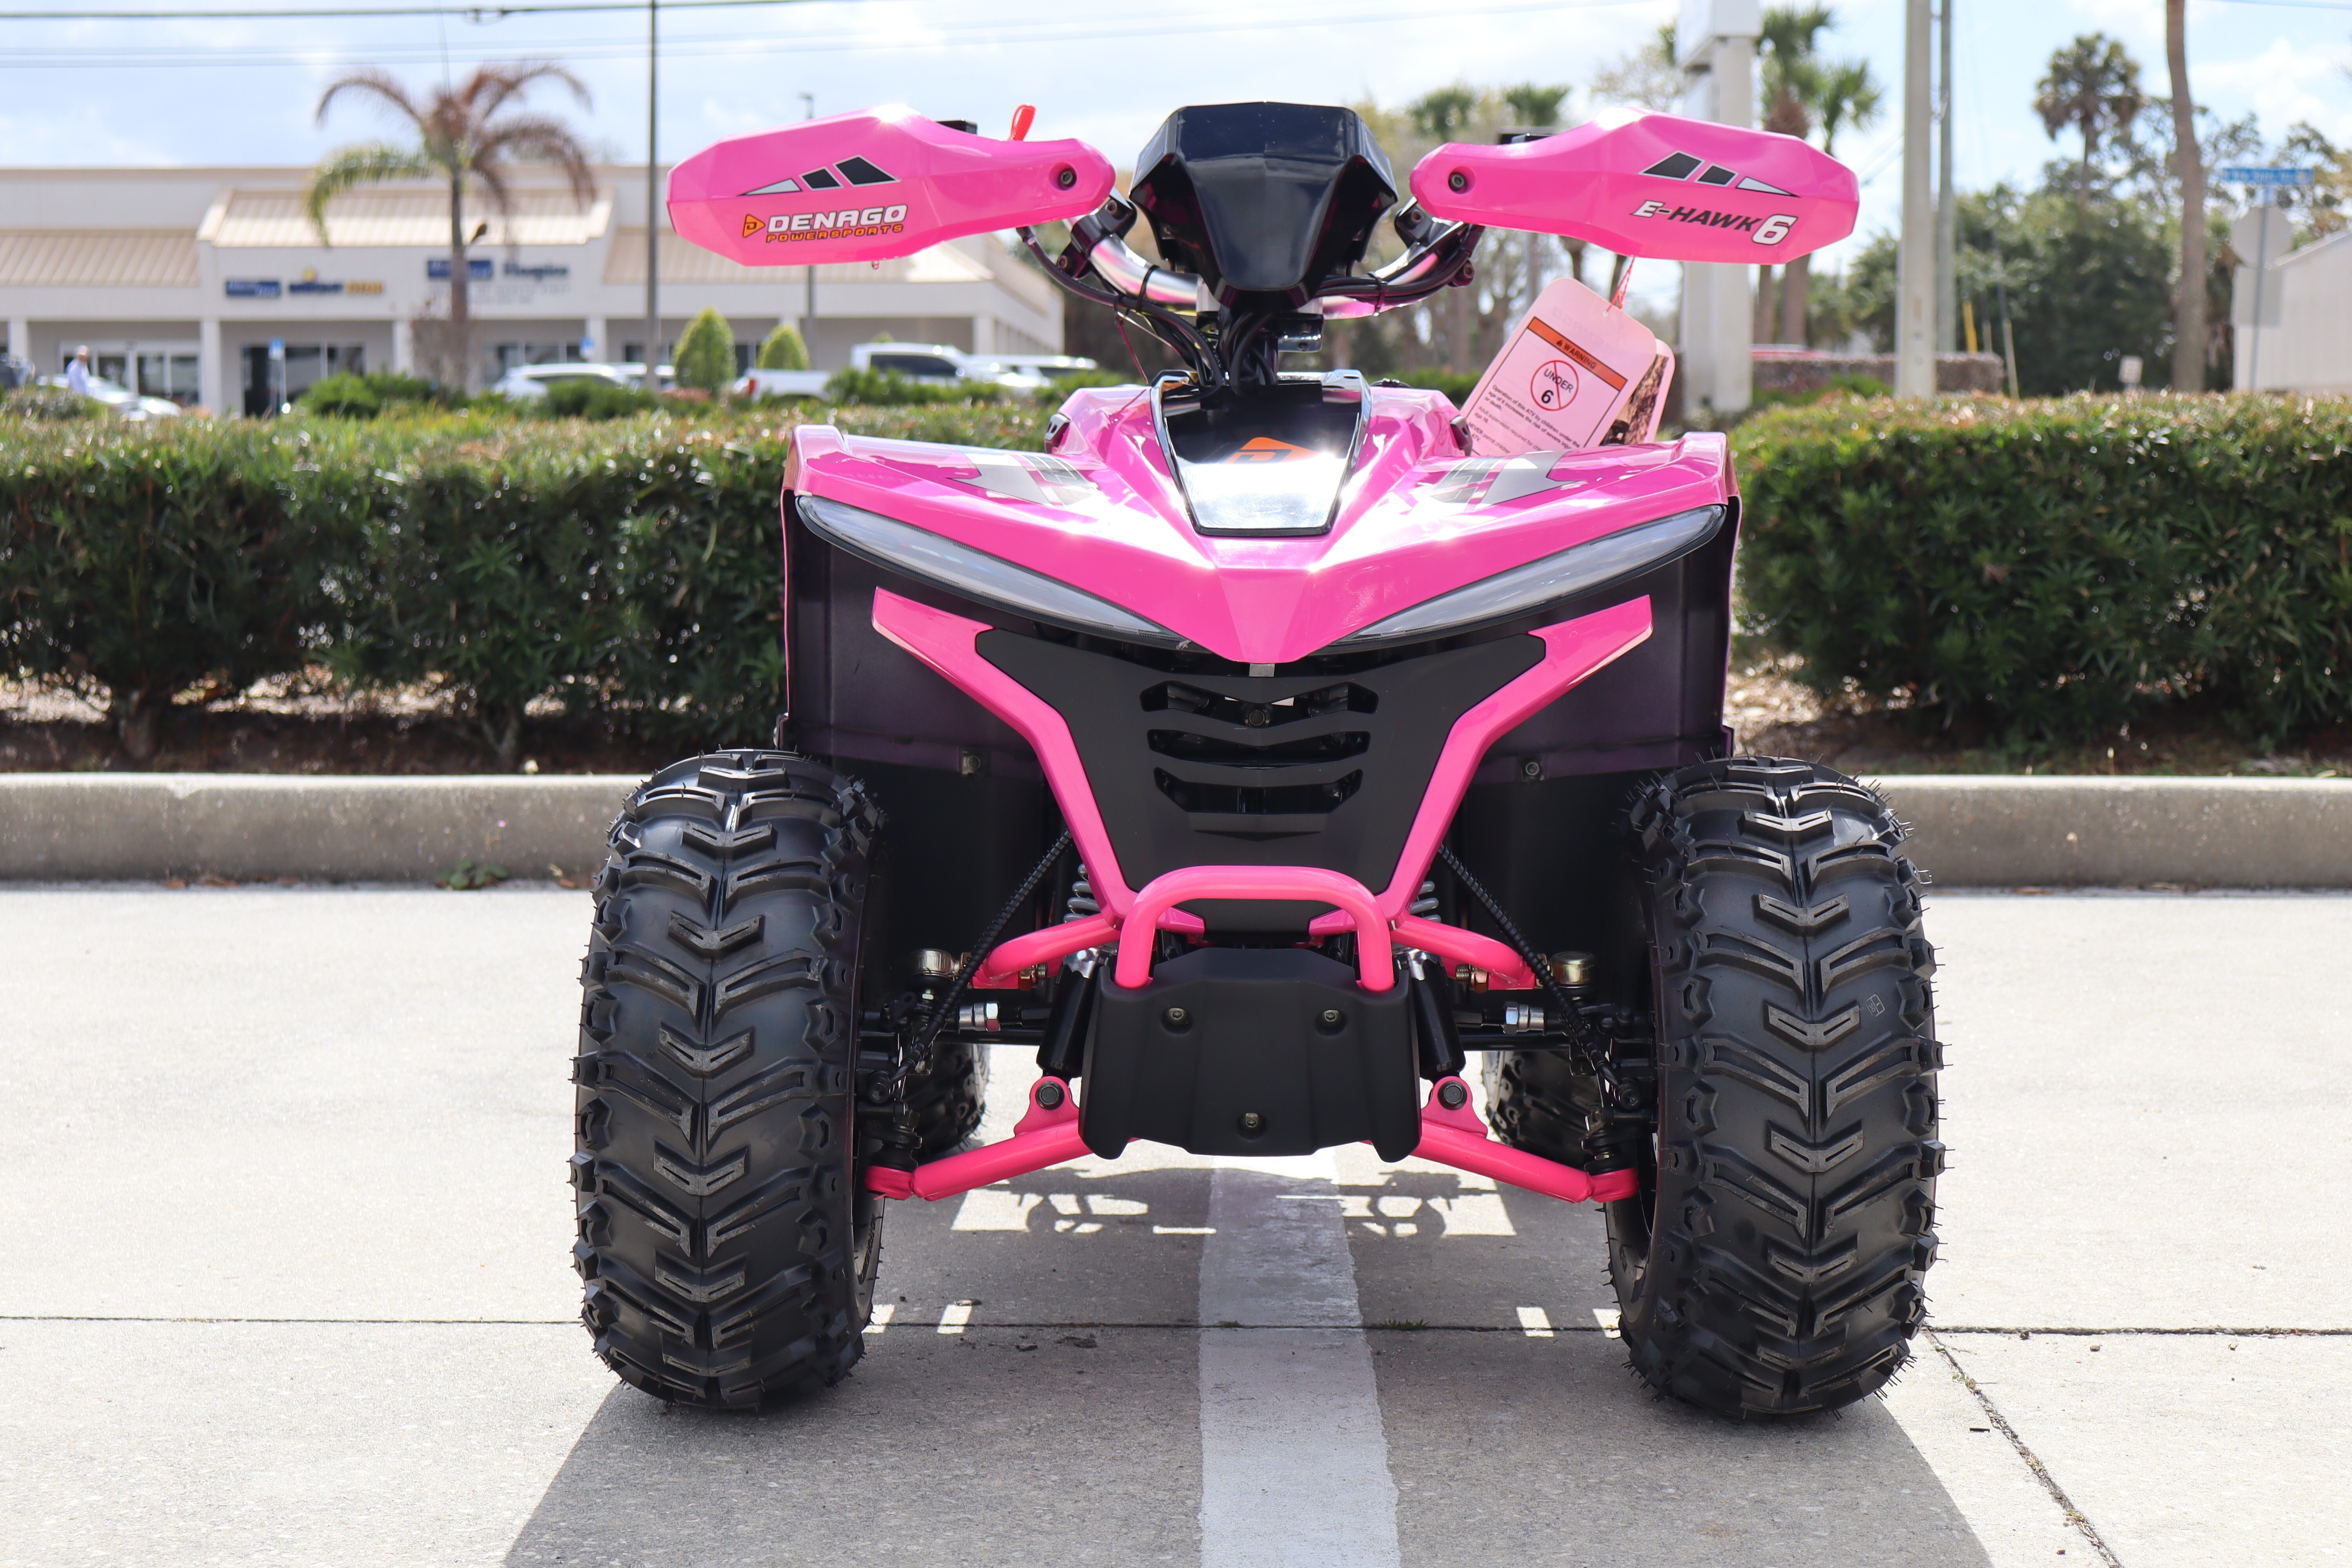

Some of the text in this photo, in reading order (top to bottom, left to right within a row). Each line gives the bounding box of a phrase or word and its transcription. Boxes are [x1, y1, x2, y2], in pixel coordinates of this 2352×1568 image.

[767, 204, 907, 233] DENAGO
[766, 224, 904, 243] POWERSPORTS
[1563, 344, 1597, 368] WARNING
[1544, 369, 1573, 392] UNDER
[1541, 390, 1554, 404] 6
[1492, 385, 1513, 400] Operation
[1541, 419, 1559, 433] children
[1559, 432, 1572, 442] under
[1505, 403, 1524, 417] increases
[1546, 432, 1561, 442] severe
[1468, 423, 1483, 434] NEVER
[1483, 434, 1495, 443] permit
[1488, 414, 1510, 430] supervision
[1510, 429, 1527, 441] required
